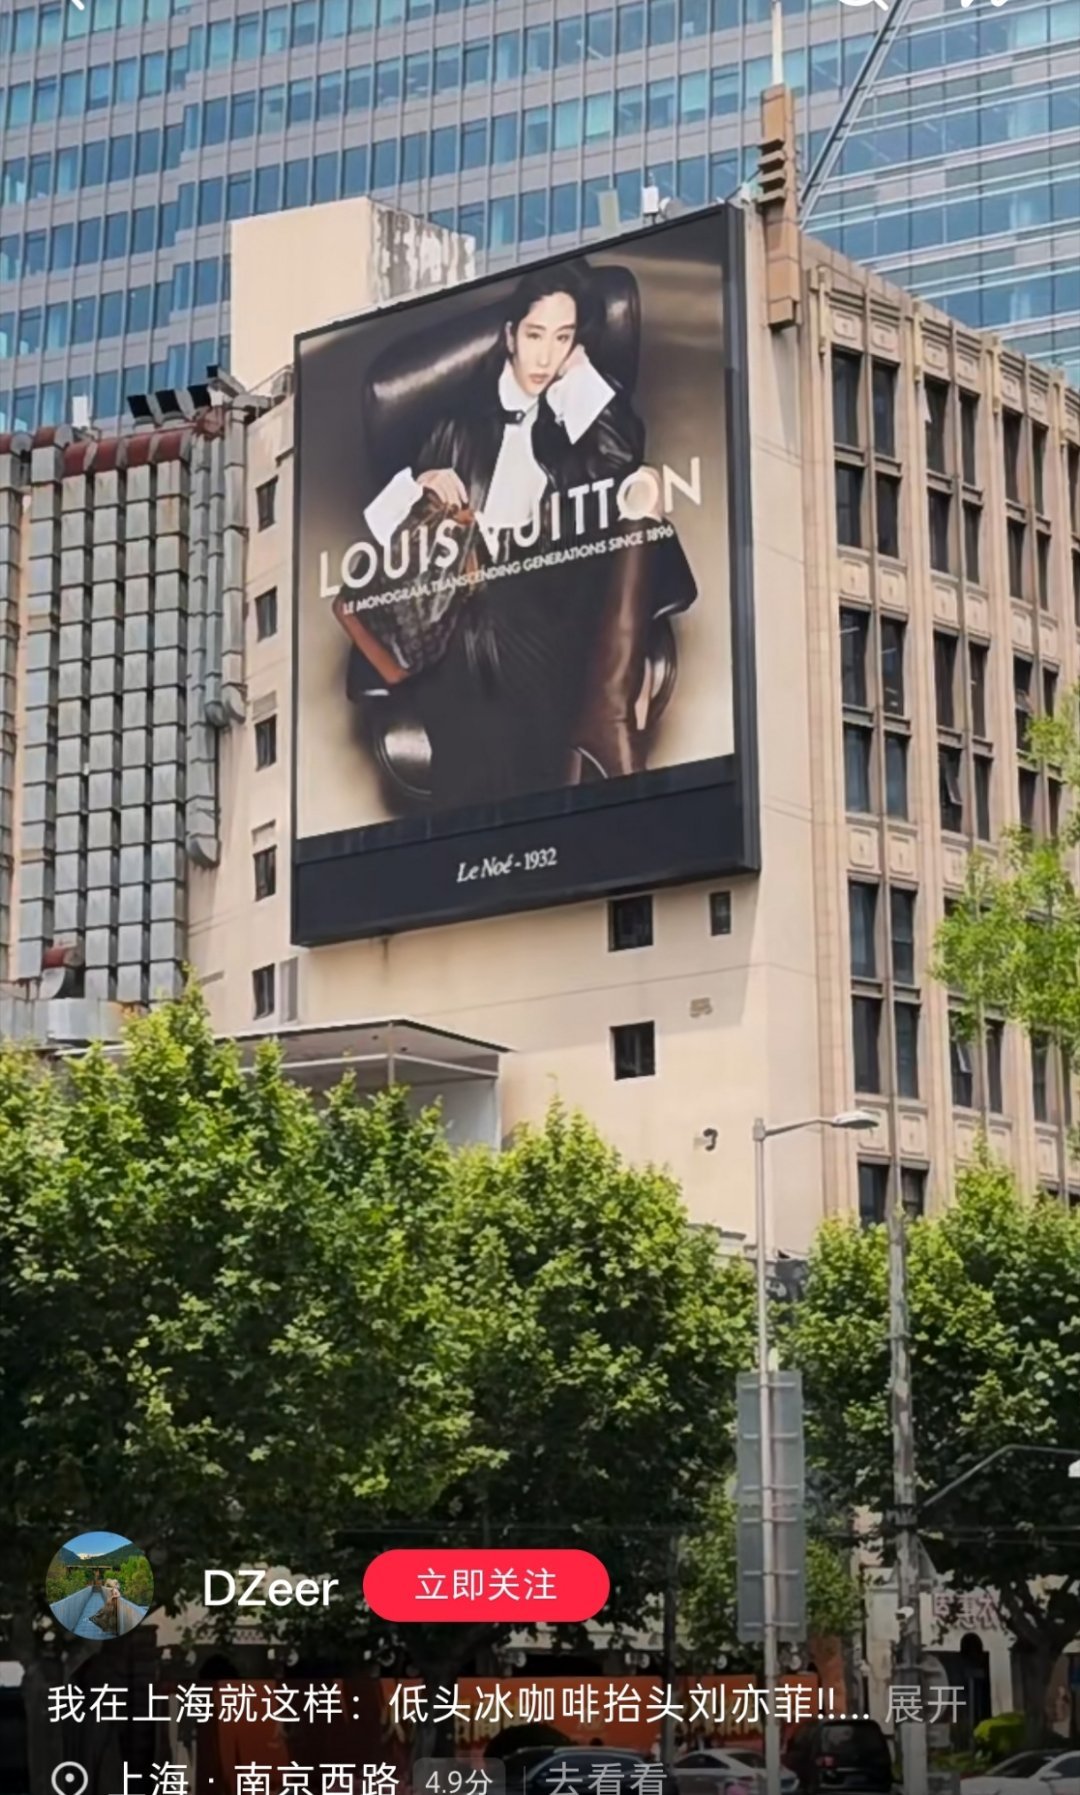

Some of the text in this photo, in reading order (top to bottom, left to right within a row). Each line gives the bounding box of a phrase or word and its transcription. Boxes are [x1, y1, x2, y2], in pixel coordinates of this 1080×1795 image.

[319, 456, 701, 598] LOUIS VUITTON
[343, 601, 355, 615] LE
[432, 562, 521, 592] TRANSCENDING
[523, 540, 606, 570] GENERATIONS
[608, 530, 644, 552] SINCE
[646, 524, 674, 542] 1896
[456, 862, 479, 883] Le
[480, 853, 514, 879] Noé
[524, 847, 557, 870] 1932
